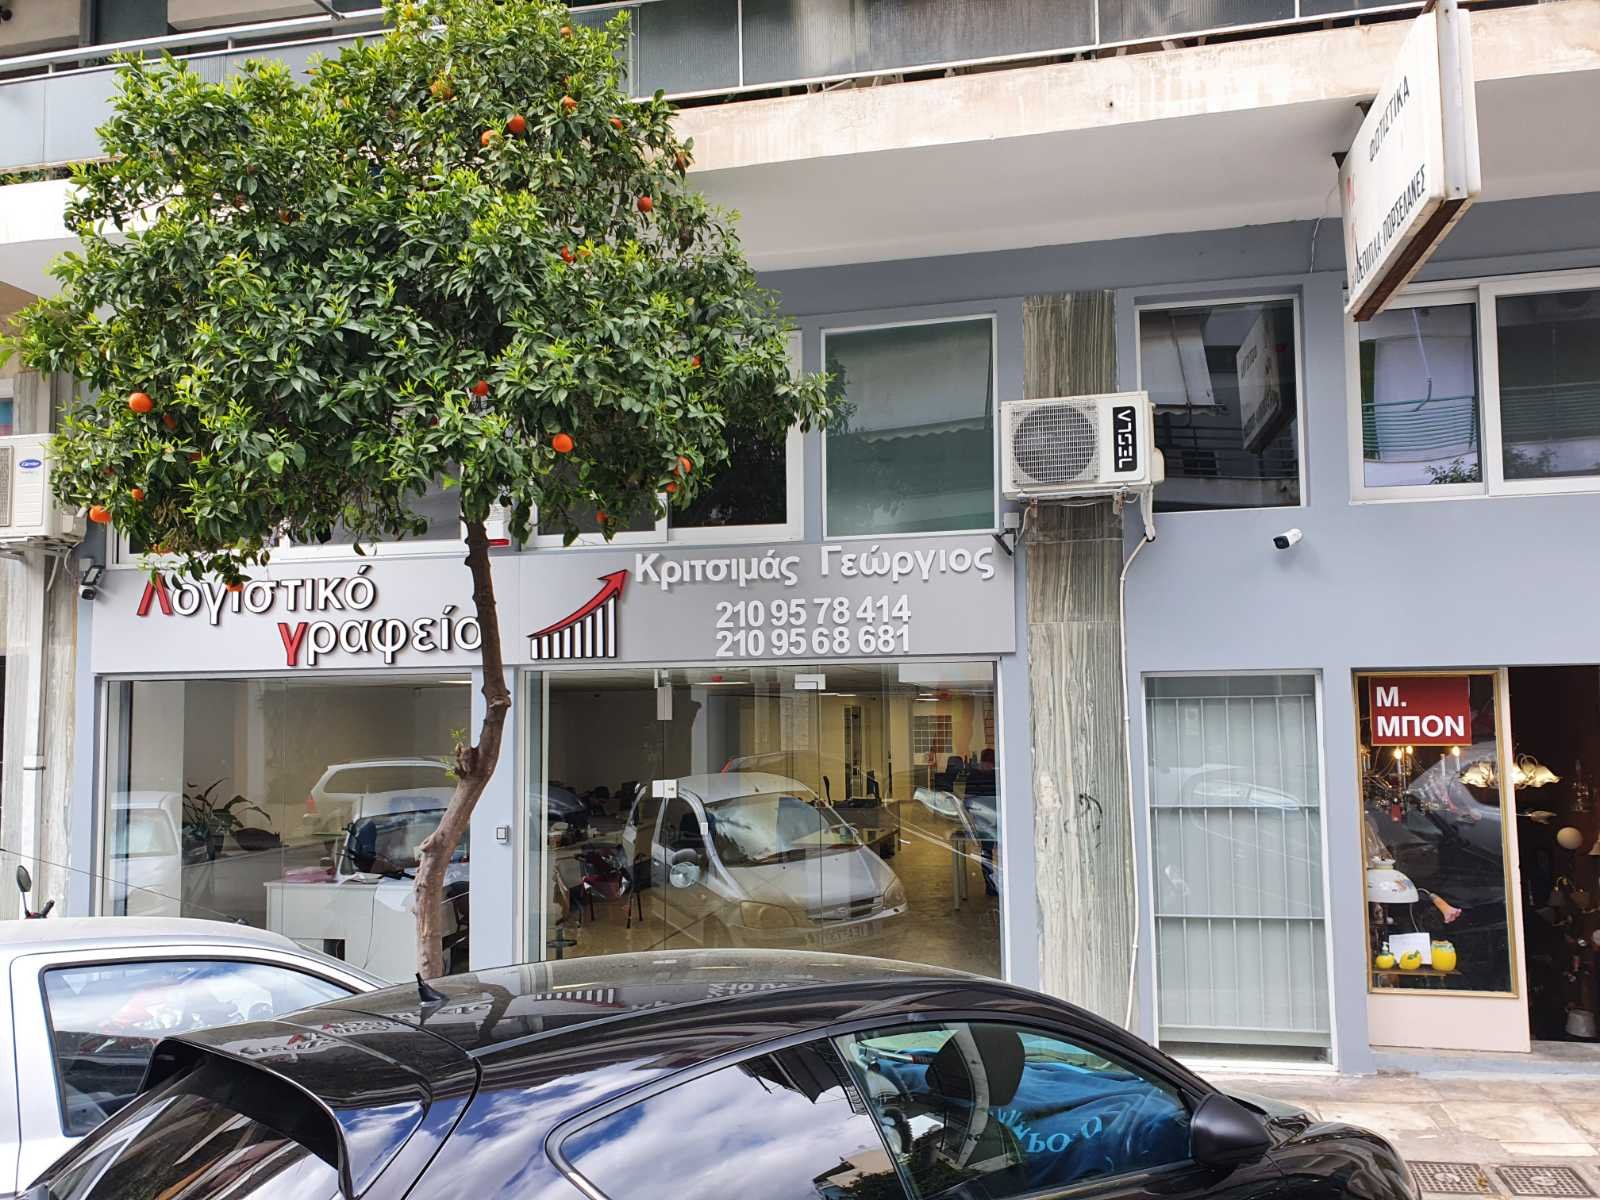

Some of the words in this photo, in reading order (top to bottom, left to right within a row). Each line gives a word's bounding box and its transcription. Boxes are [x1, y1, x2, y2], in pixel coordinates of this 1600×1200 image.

[1117, 409, 1133, 469] TESLA
[635, 549, 801, 591] Κριτσιμάς
[819, 544, 995, 584] Γεώργιος
[137, 565, 377, 626] Λογιστικό
[715, 600, 765, 629] 210
[770, 599, 806, 627] 95
[813, 597, 850, 625] 78
[856, 595, 912, 624] 414
[278, 605, 482, 667] γραφείο
[715, 629, 765, 658] 210
[770, 627, 806, 656] 95
[812, 626, 850, 655] 68
[857, 624, 911, 654] 681
[1376, 686, 1408, 708] Μ.
[1377, 715, 1466, 738] ΜΠΟΝ
